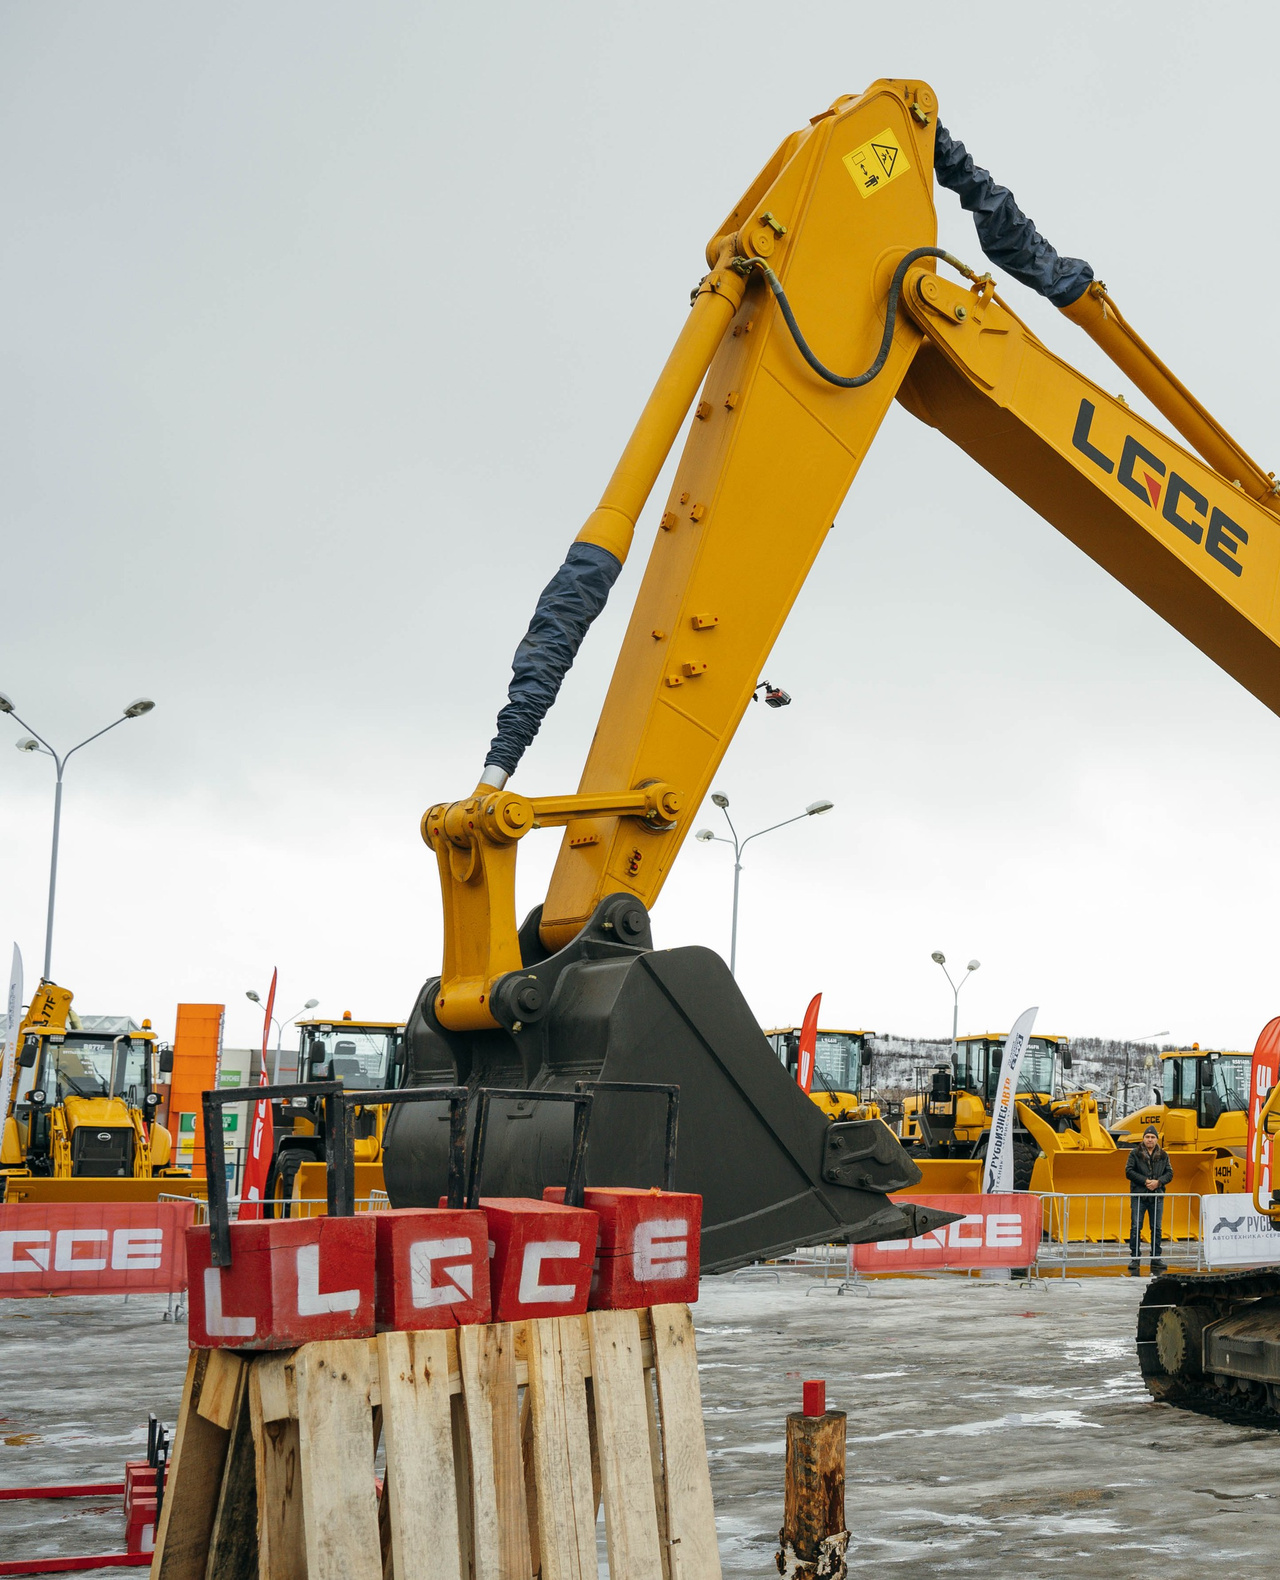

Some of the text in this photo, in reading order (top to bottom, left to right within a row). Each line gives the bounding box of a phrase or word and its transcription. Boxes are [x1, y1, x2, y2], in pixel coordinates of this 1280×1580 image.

[1072, 398, 1248, 577] LGCE
[1140, 1116, 1160, 1124] LGCE
[1215, 1166, 1231, 1177] 140H
[634, 1219, 688, 1281] E
[1212, 1233, 1262, 1241] АВТОТЕХНИКА
[203, 1267, 257, 1337] L
[297, 1245, 360, 1316] L
[518, 1241, 581, 1304] C
